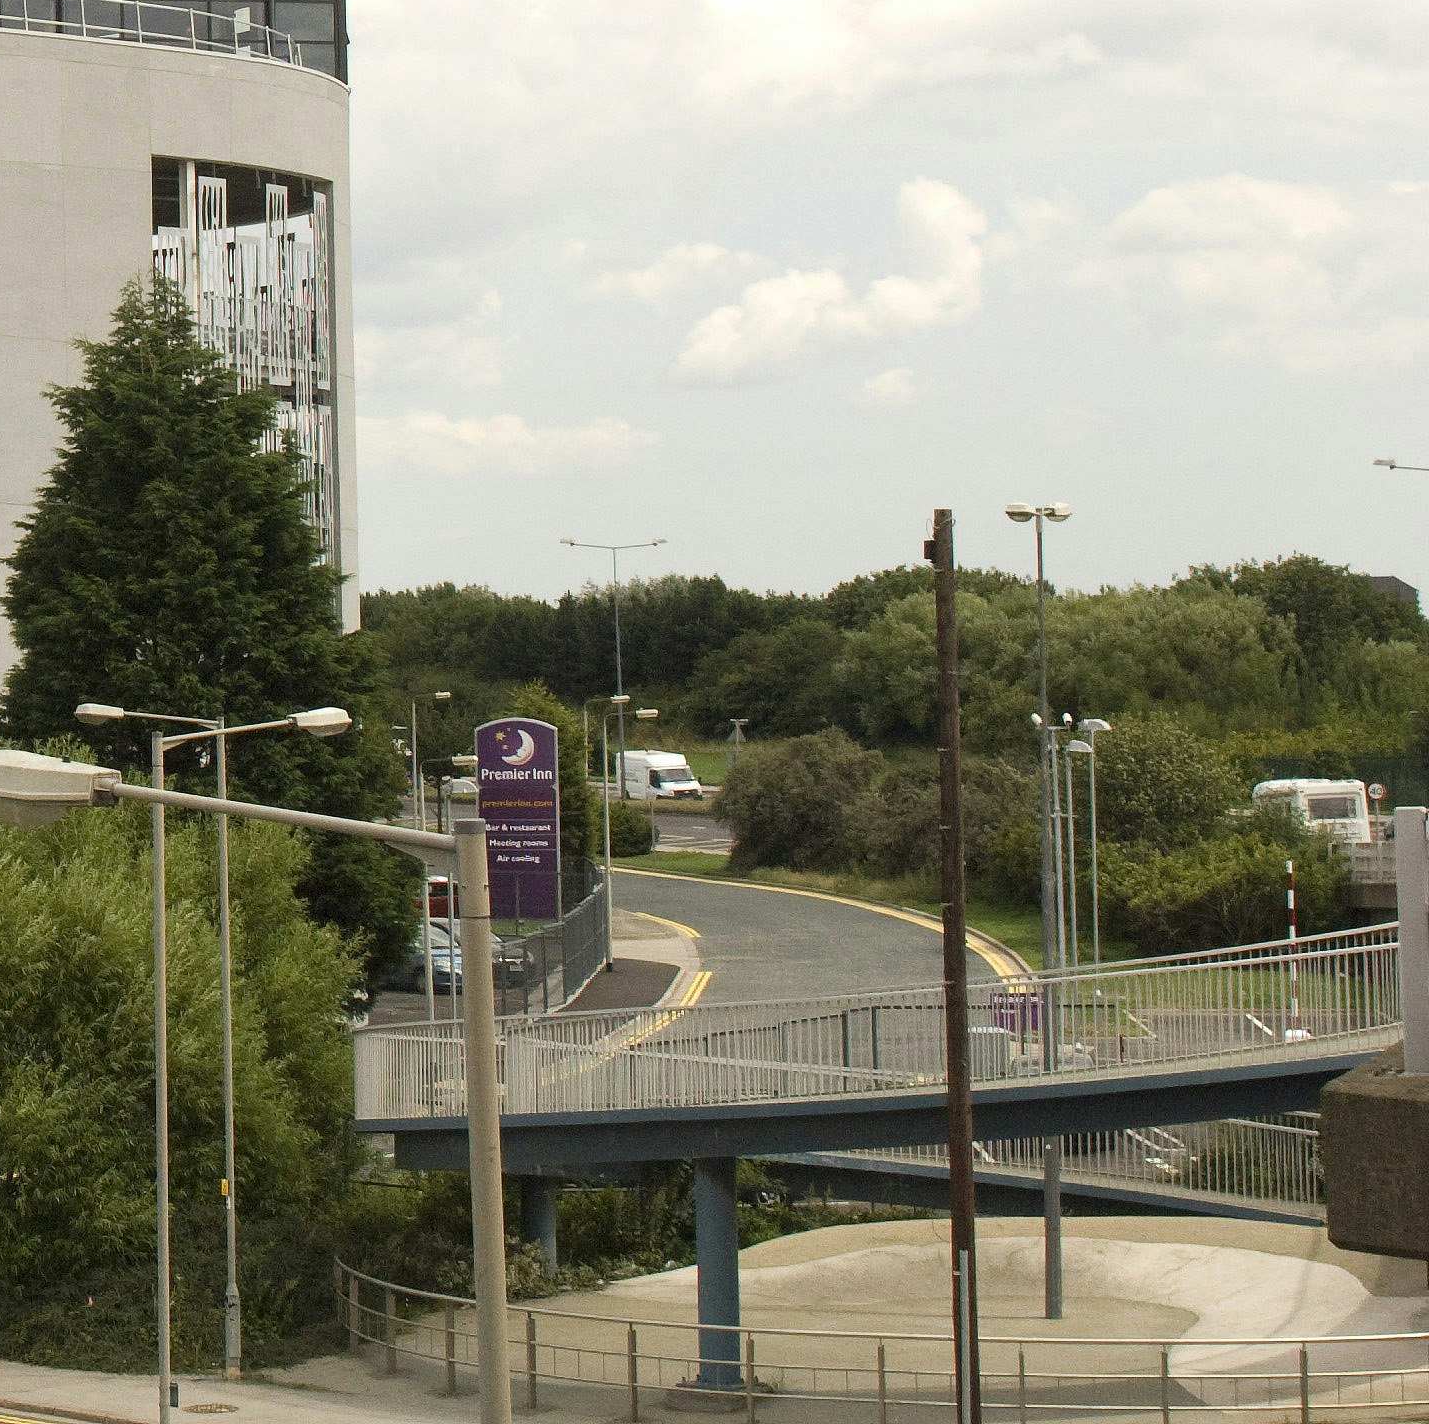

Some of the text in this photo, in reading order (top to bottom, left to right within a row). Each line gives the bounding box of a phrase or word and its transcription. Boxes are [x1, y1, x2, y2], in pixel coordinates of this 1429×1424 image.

[481, 768, 553, 780] Premier Inn
[489, 838, 521, 848] Meeting
[496, 854, 541, 864] Air cooling
